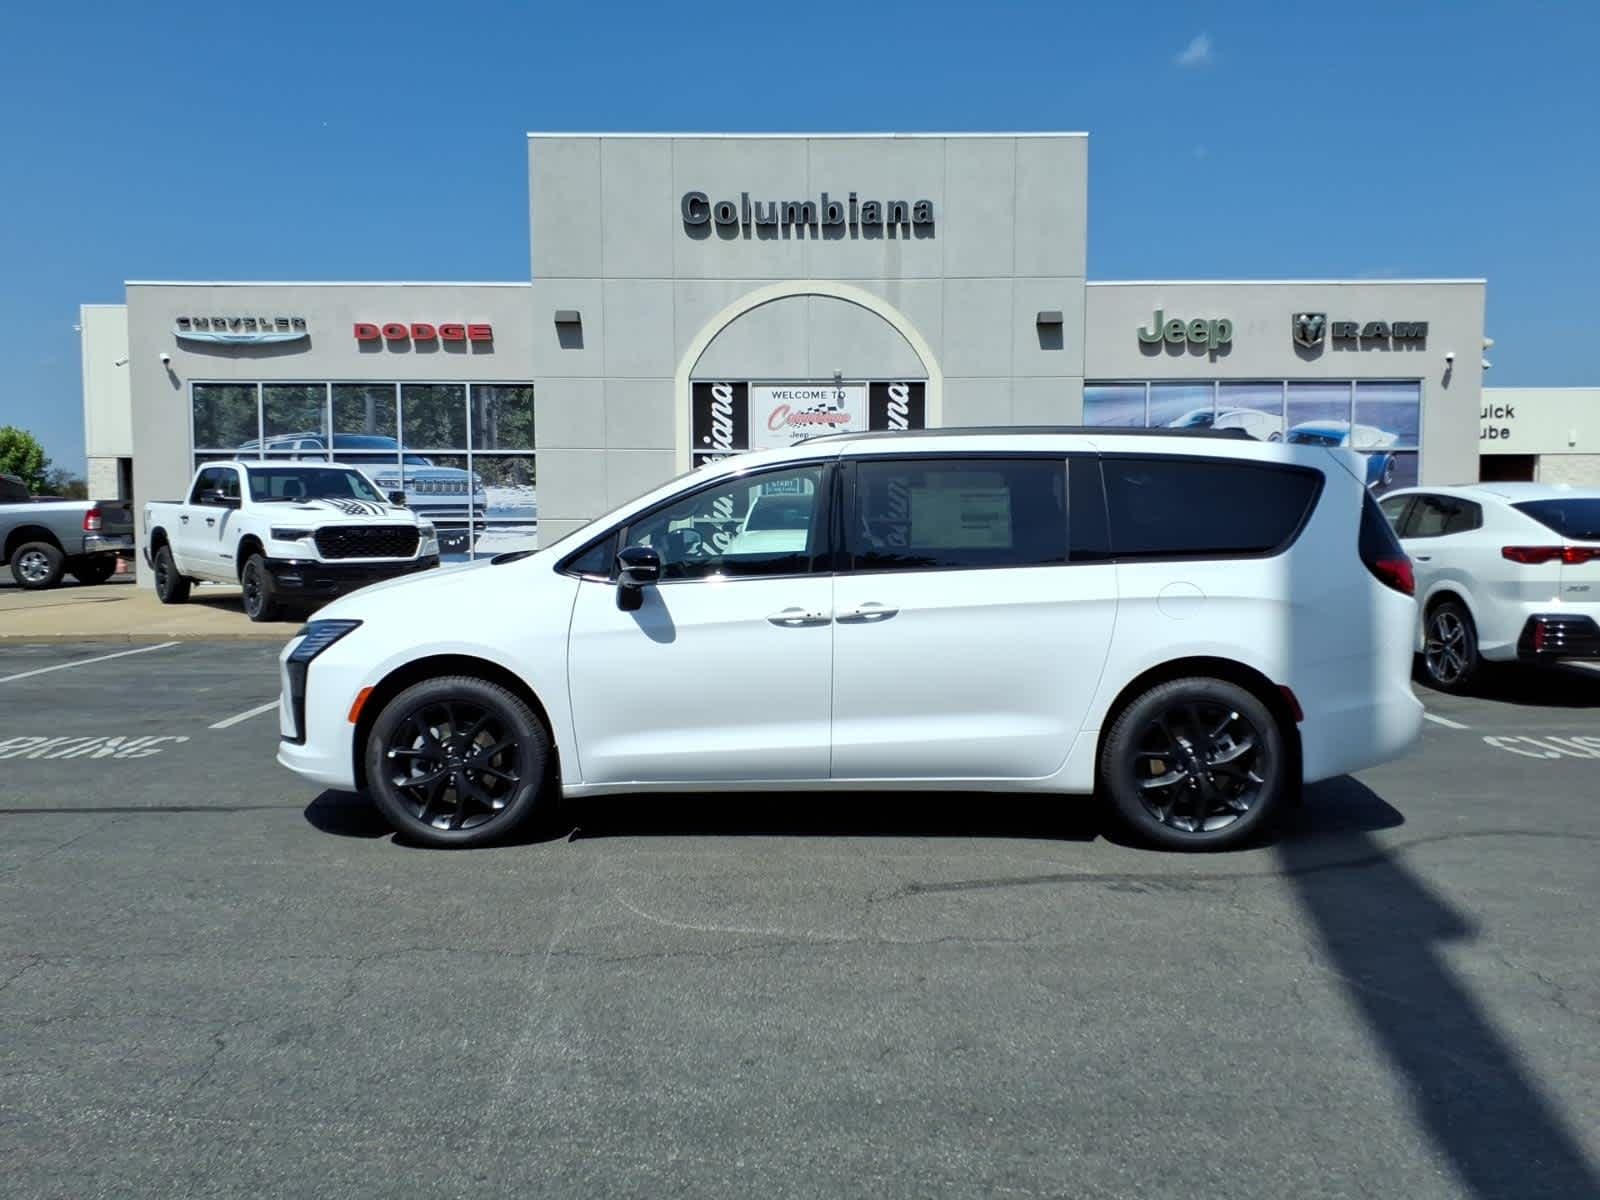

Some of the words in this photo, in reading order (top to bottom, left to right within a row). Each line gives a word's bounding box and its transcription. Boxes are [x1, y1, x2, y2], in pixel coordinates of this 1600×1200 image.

[680, 191, 935, 225] Columbiana
[353, 322, 493, 341] DODGE
[1136, 309, 1233, 350] Jeep
[1331, 321, 1429, 339] RAM
[772, 391, 827, 400] WELCOME
[832, 391, 846, 400] TO
